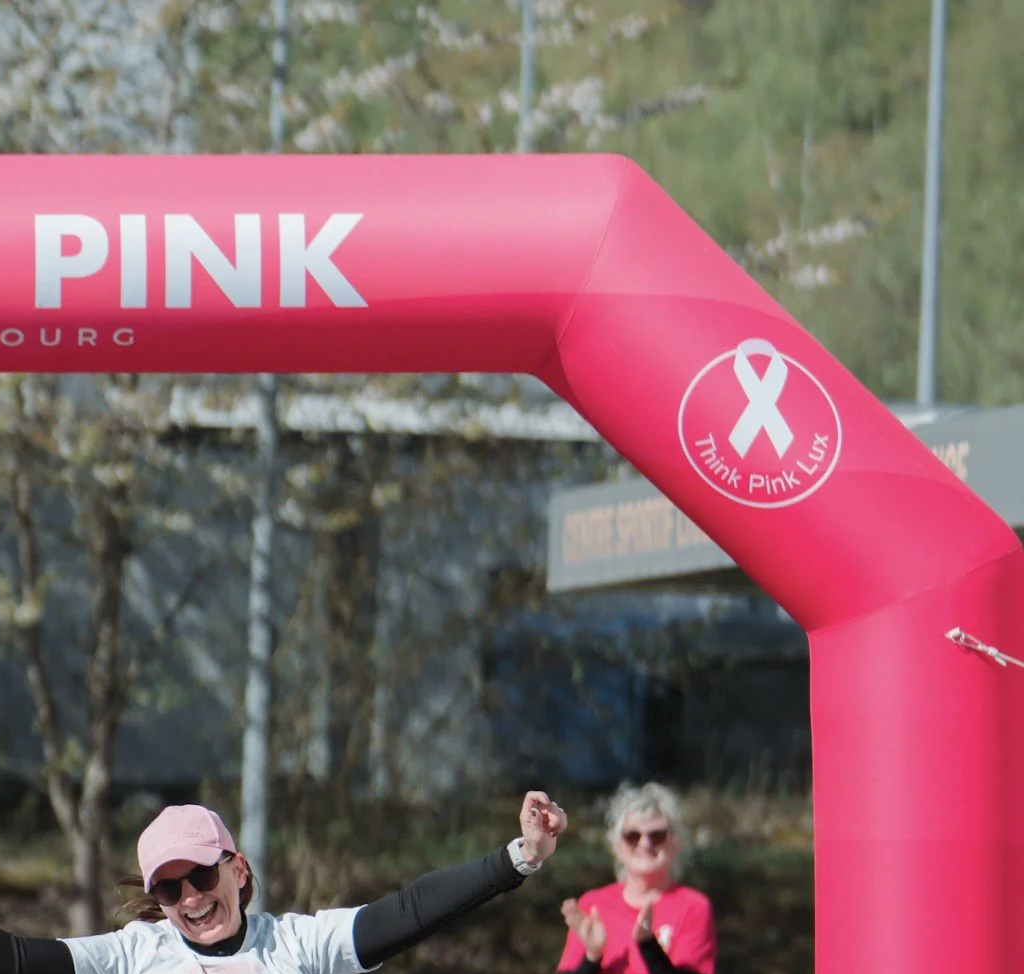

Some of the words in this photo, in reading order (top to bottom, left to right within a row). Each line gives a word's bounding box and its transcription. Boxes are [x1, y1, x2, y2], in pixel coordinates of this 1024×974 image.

[34, 212, 369, 309] PINK
[695, 432, 742, 488] Think
[748, 470, 801, 495] Pink
[796, 433, 829, 475] Lux
